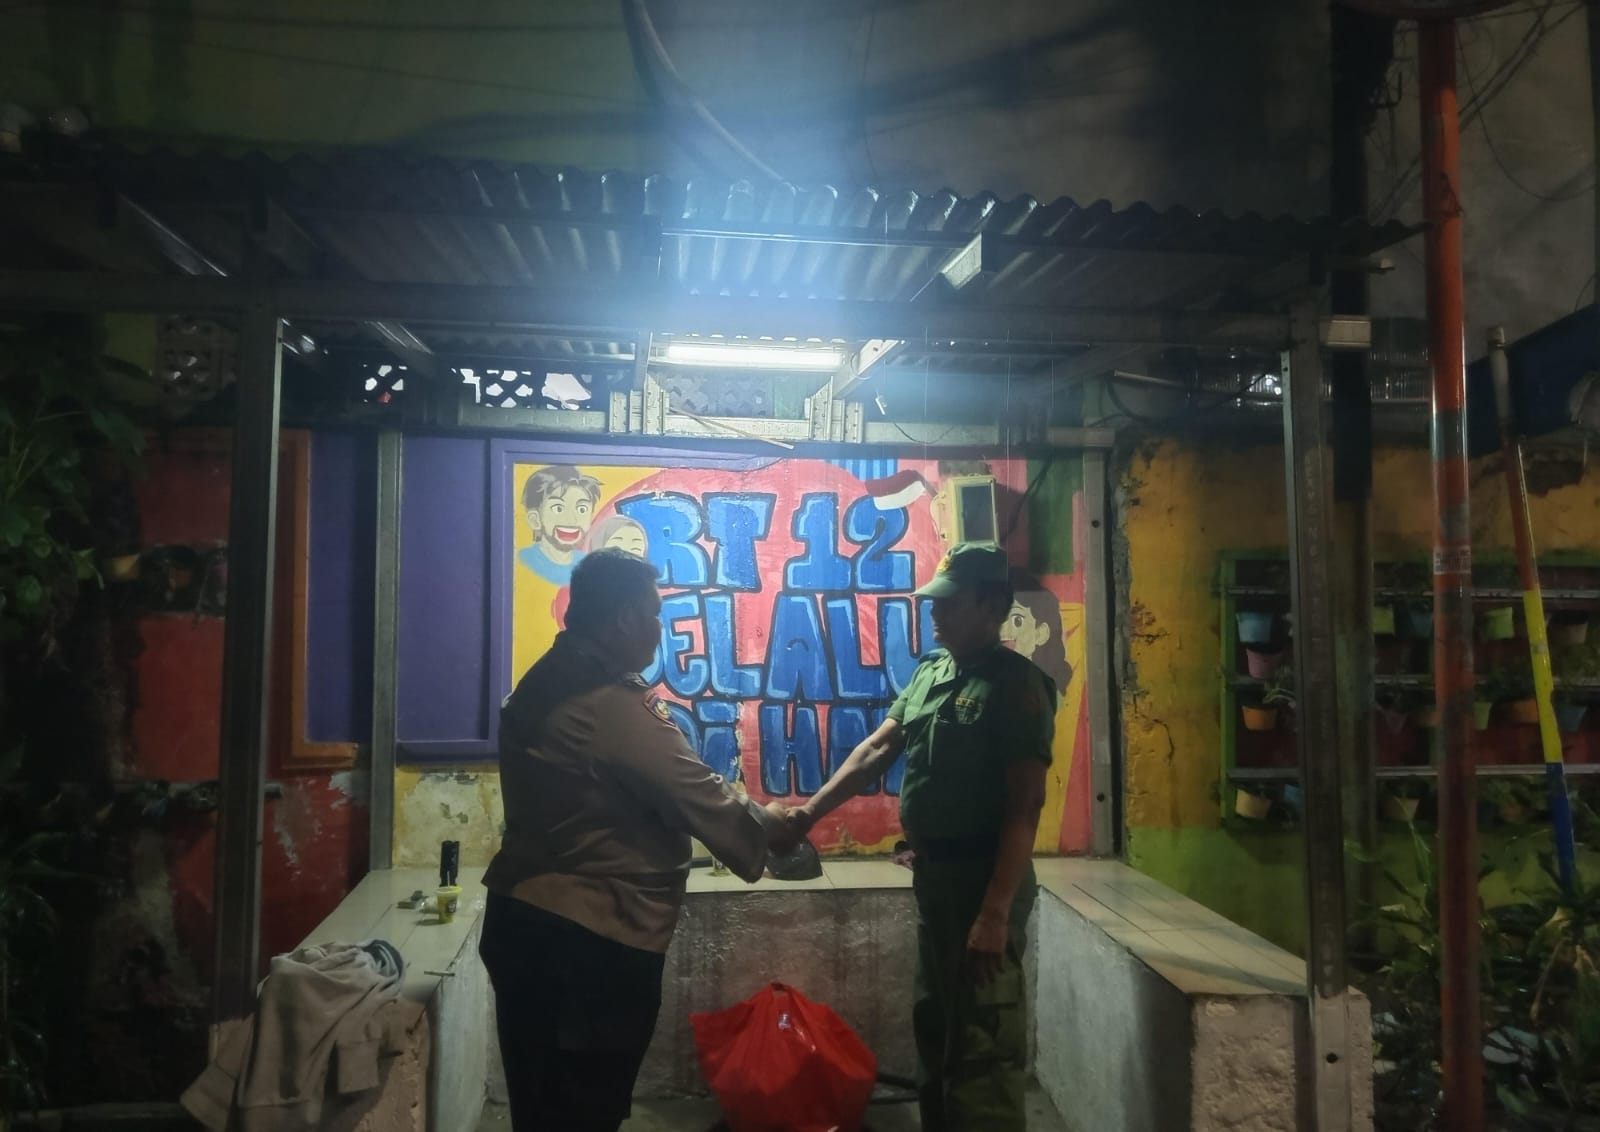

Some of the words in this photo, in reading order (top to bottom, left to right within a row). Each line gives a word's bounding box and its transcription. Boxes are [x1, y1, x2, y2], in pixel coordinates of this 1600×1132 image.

[614, 491, 777, 592] RT
[782, 492, 916, 593] 12
[639, 590, 937, 702] ELALU
